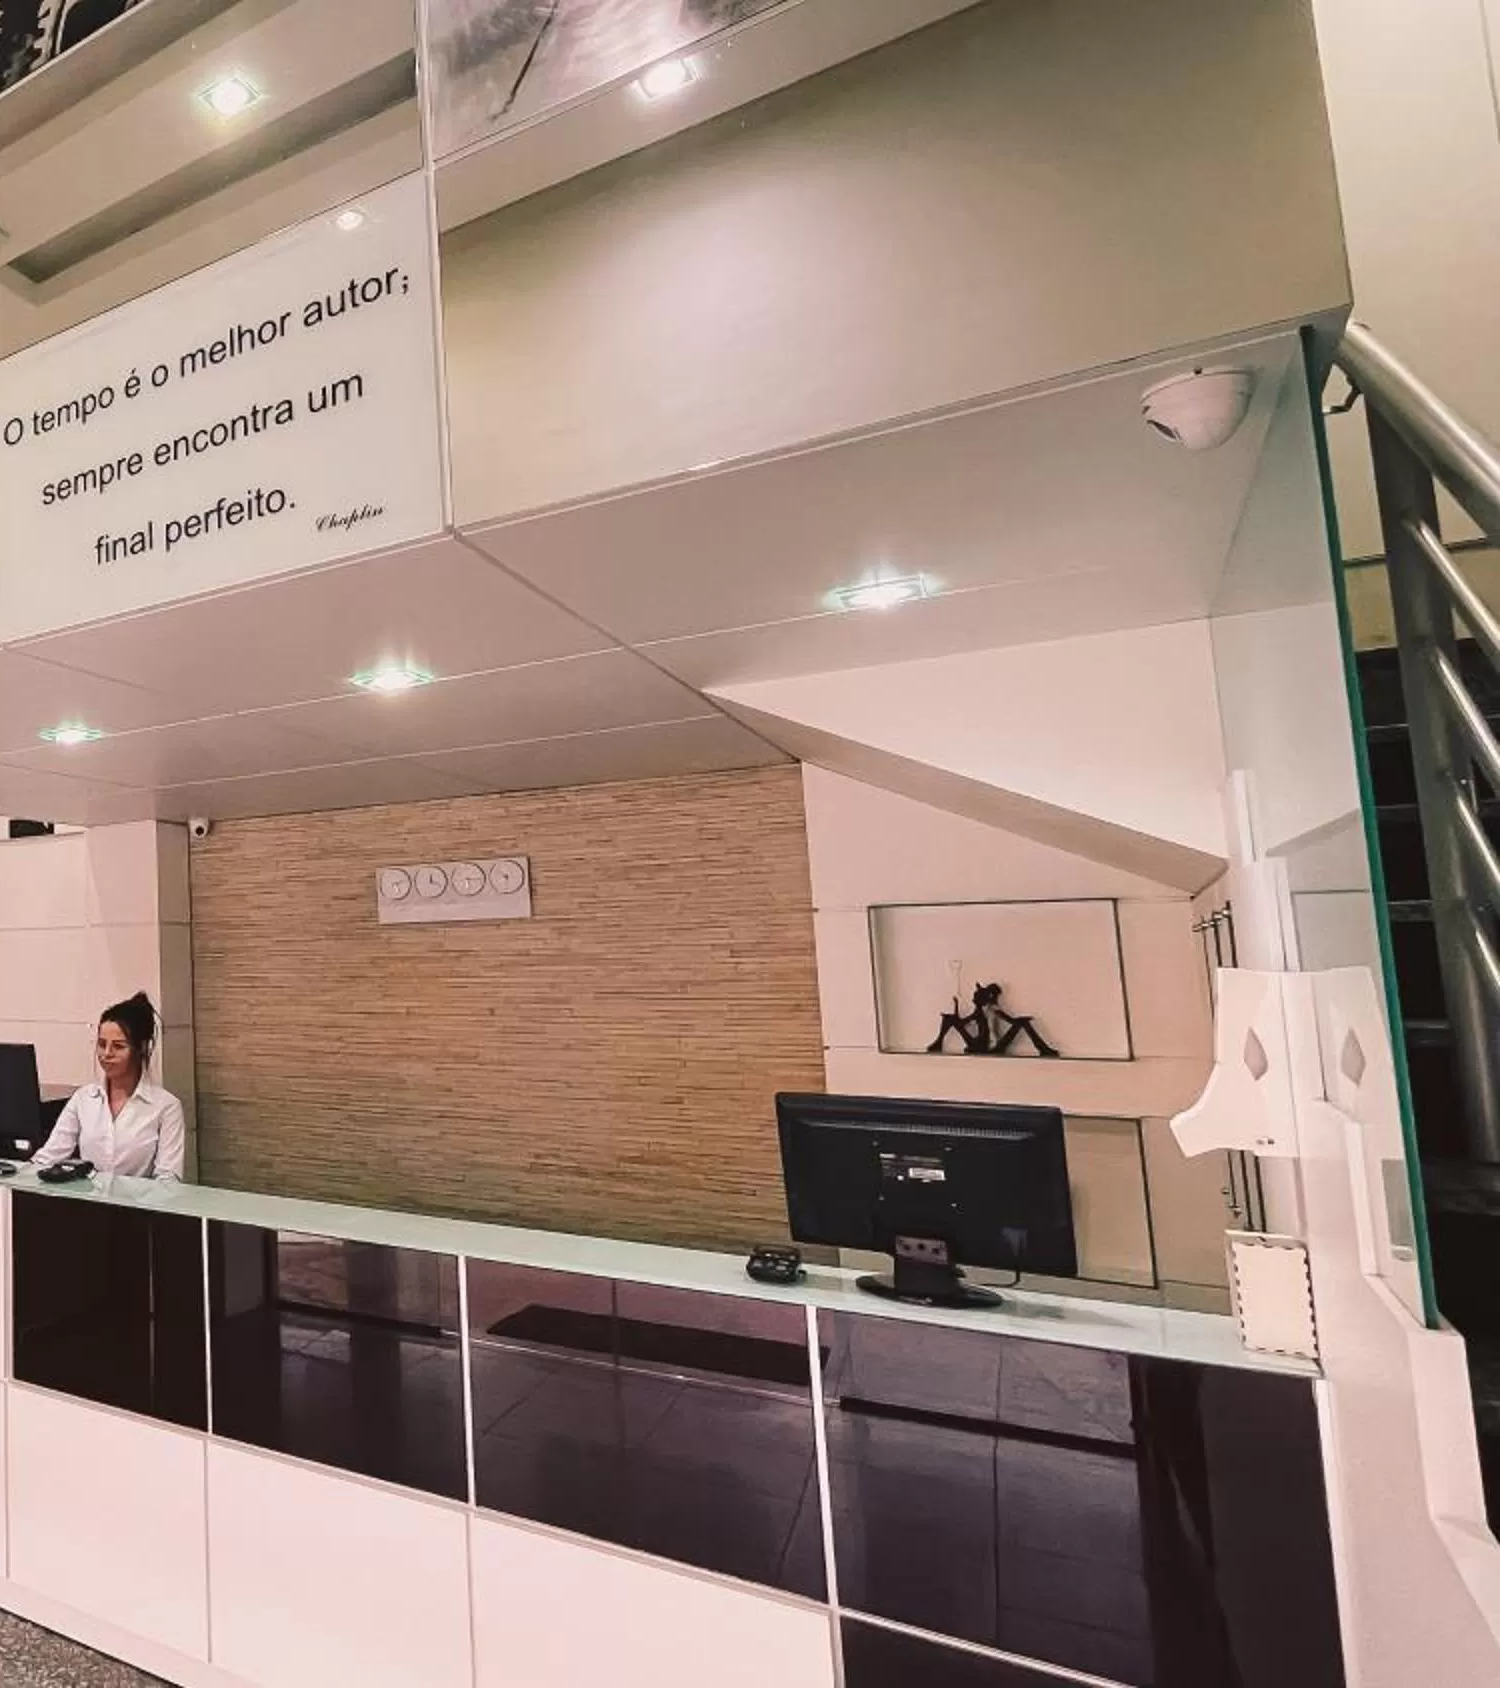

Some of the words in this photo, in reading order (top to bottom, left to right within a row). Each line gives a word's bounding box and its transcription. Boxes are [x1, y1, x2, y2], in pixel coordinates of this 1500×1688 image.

[2, 417, 24, 447] O
[32, 384, 115, 434] tempo
[124, 369, 141, 399] é
[151, 363, 169, 388] o
[179, 311, 291, 379] melhor
[302, 266, 410, 329] autor;
[41, 452, 144, 506] sempre
[153, 397, 295, 466] encontra
[307, 373, 364, 414] um
[93, 521, 154, 567] final
[164, 487, 296, 552] perfeito.
[314, 502, 388, 533] Chaplin
